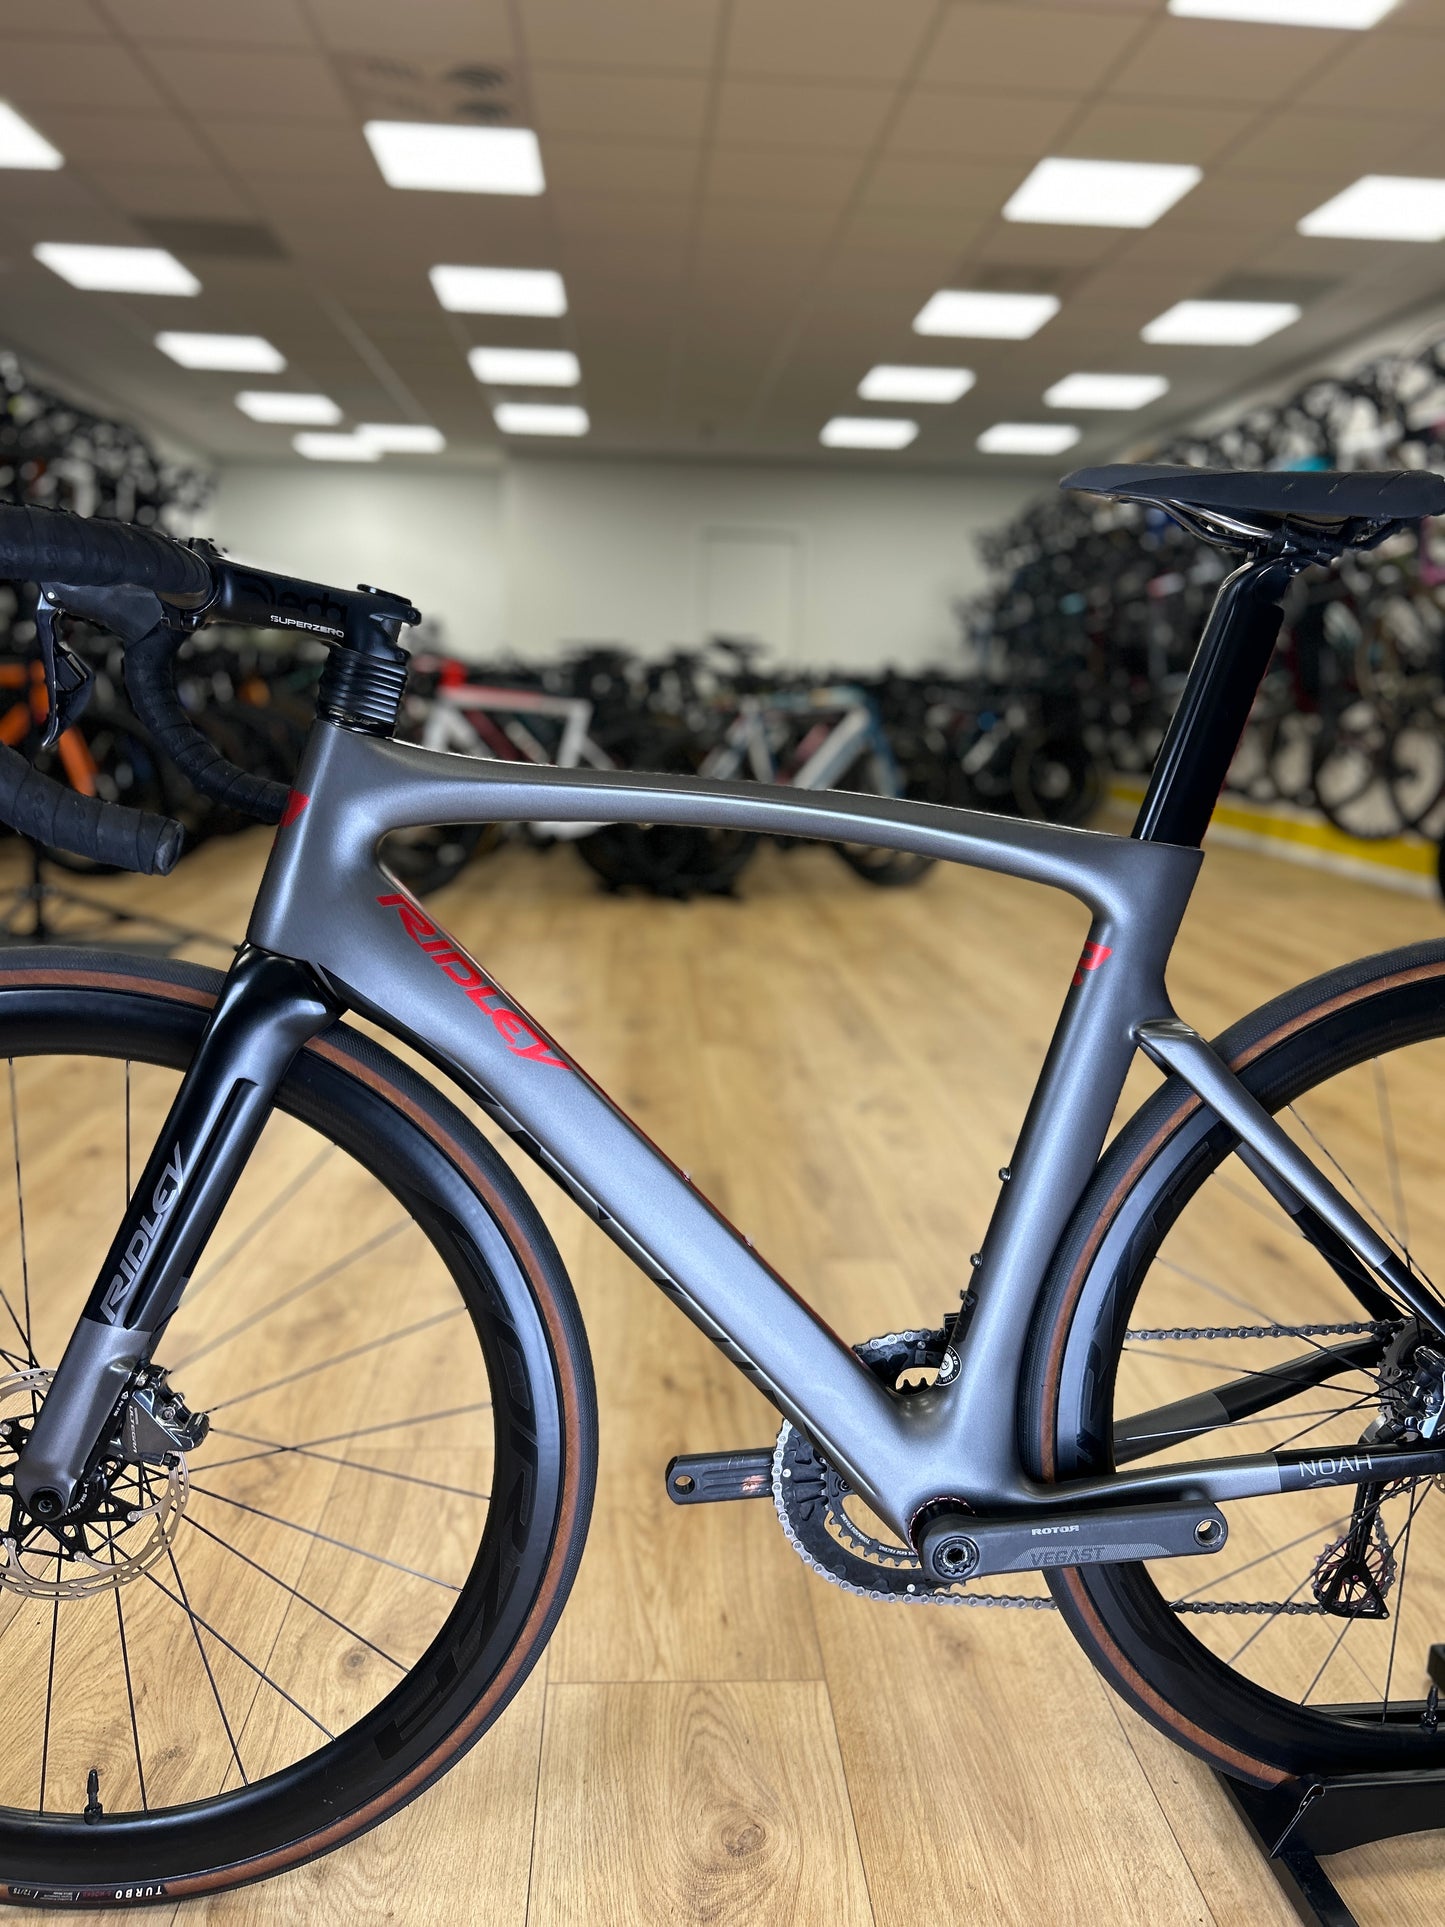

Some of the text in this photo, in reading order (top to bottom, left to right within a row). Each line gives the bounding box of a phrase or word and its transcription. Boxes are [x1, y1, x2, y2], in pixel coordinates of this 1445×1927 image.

[270, 614, 345, 639] SUPERZERO
[375, 893, 573, 1071] RIDLEY
[100, 1141, 184, 1324] RIDLEY
[1299, 1453, 1373, 1477] NOAH
[1031, 1524, 1079, 1536] ROTOR
[1030, 1547, 1105, 1566] VEGAST
[115, 1885, 162, 1899] TURBO
